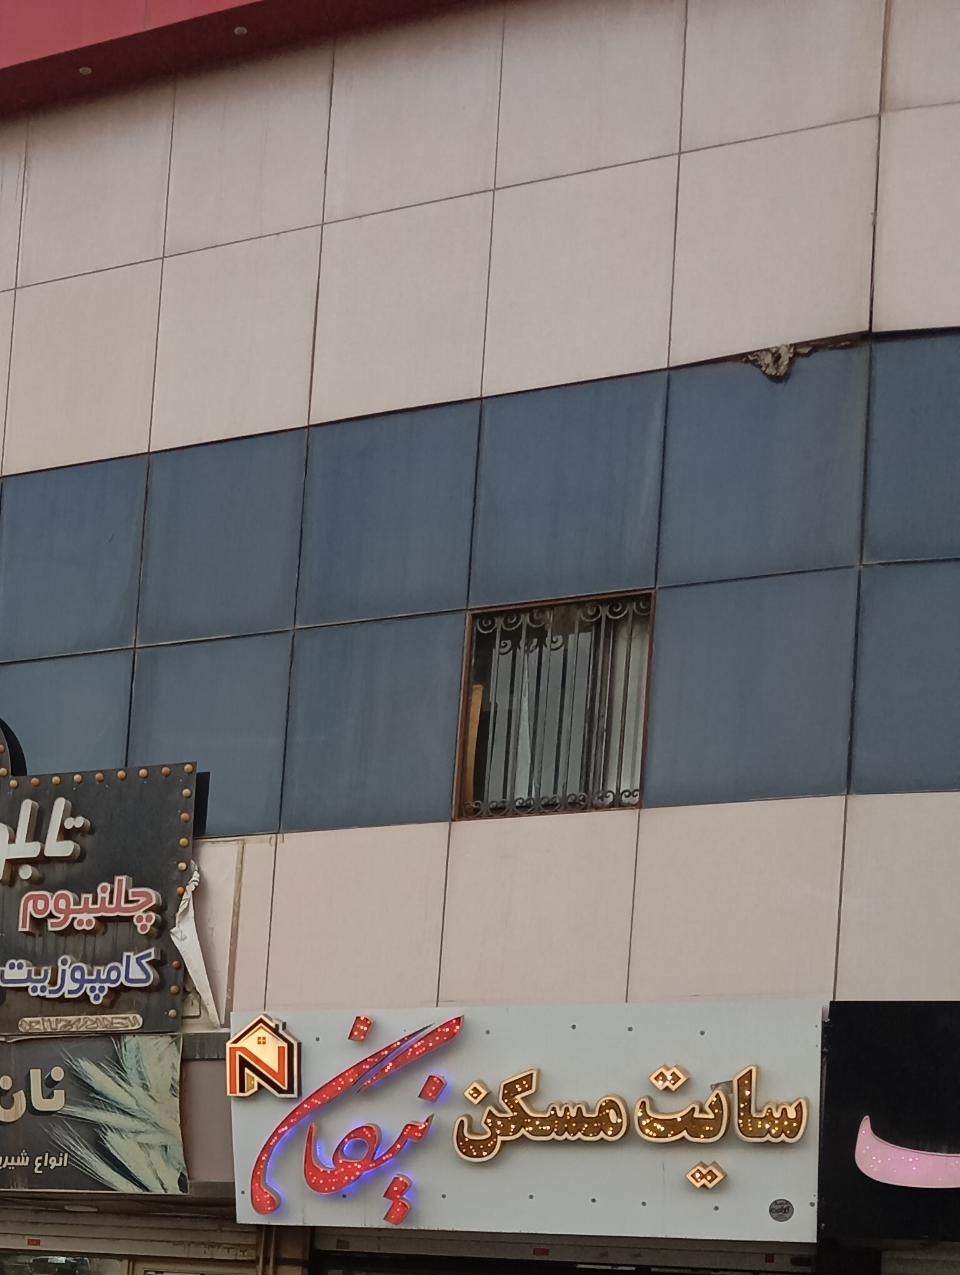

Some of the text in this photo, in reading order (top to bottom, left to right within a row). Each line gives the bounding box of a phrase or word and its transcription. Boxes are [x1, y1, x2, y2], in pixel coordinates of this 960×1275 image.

[18, 875, 160, 935] چلنیوم
[451, 1067, 631, 1163] مسکن
[634, 1063, 810, 1190] سایت
[33, 1152, 69, 1174] انواع
